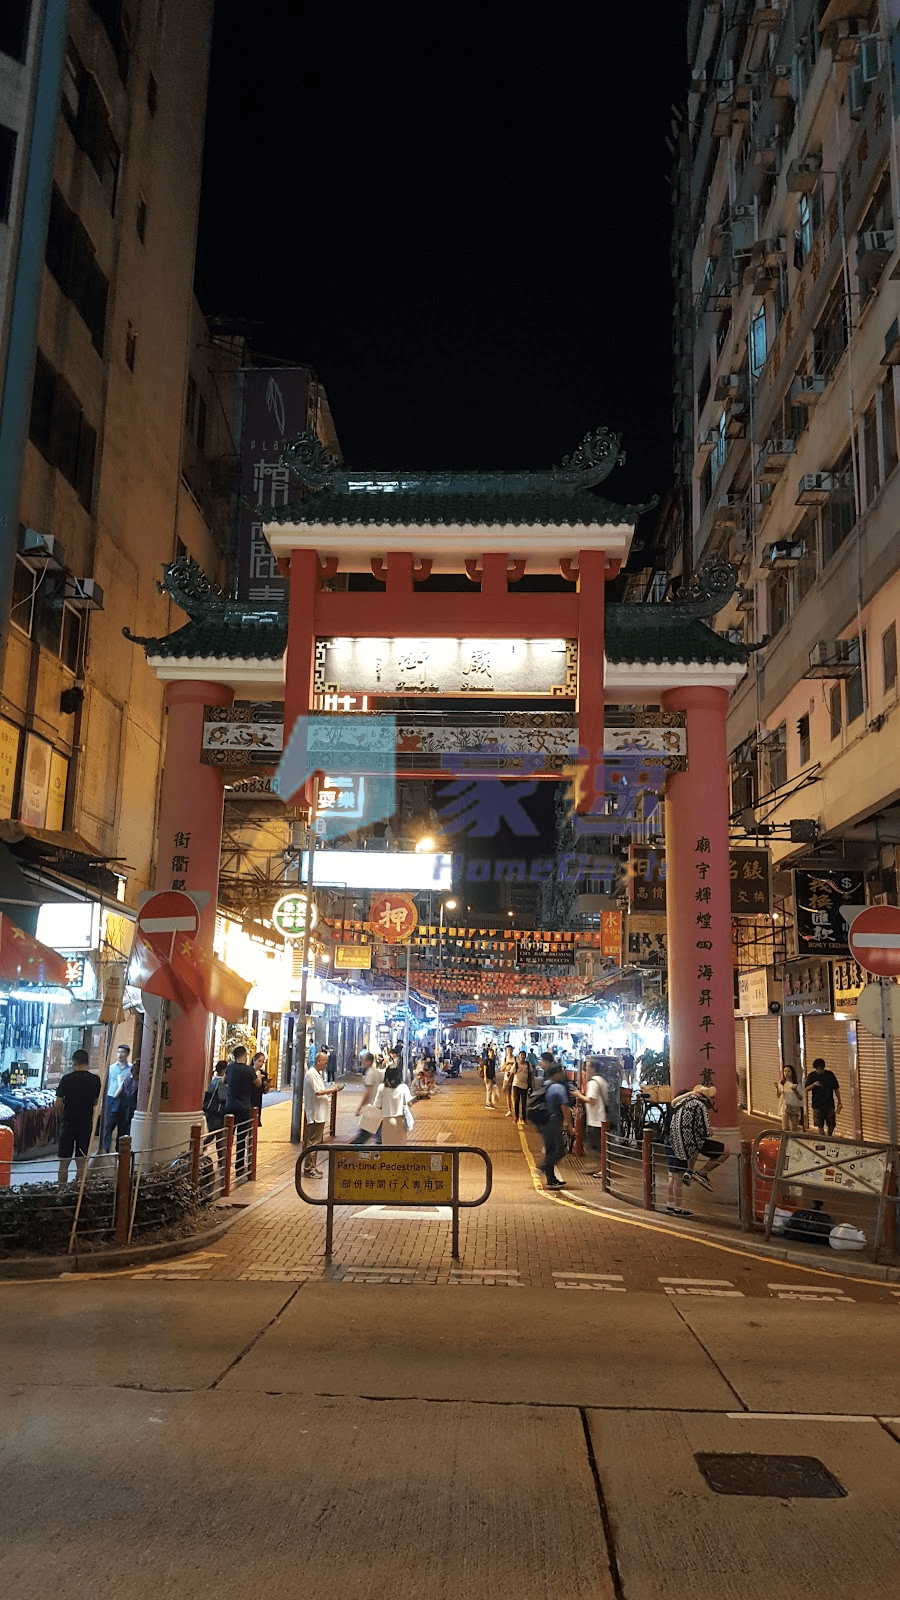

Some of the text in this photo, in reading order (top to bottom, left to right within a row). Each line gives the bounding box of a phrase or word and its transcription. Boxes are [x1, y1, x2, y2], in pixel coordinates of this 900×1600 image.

[379, 902, 408, 932] 押
[337, 1161, 376, 1171] Part-time
[380, 1162, 426, 1172] Pedestrian
[341, 1179, 444, 1190] 部份時間行人專用區
